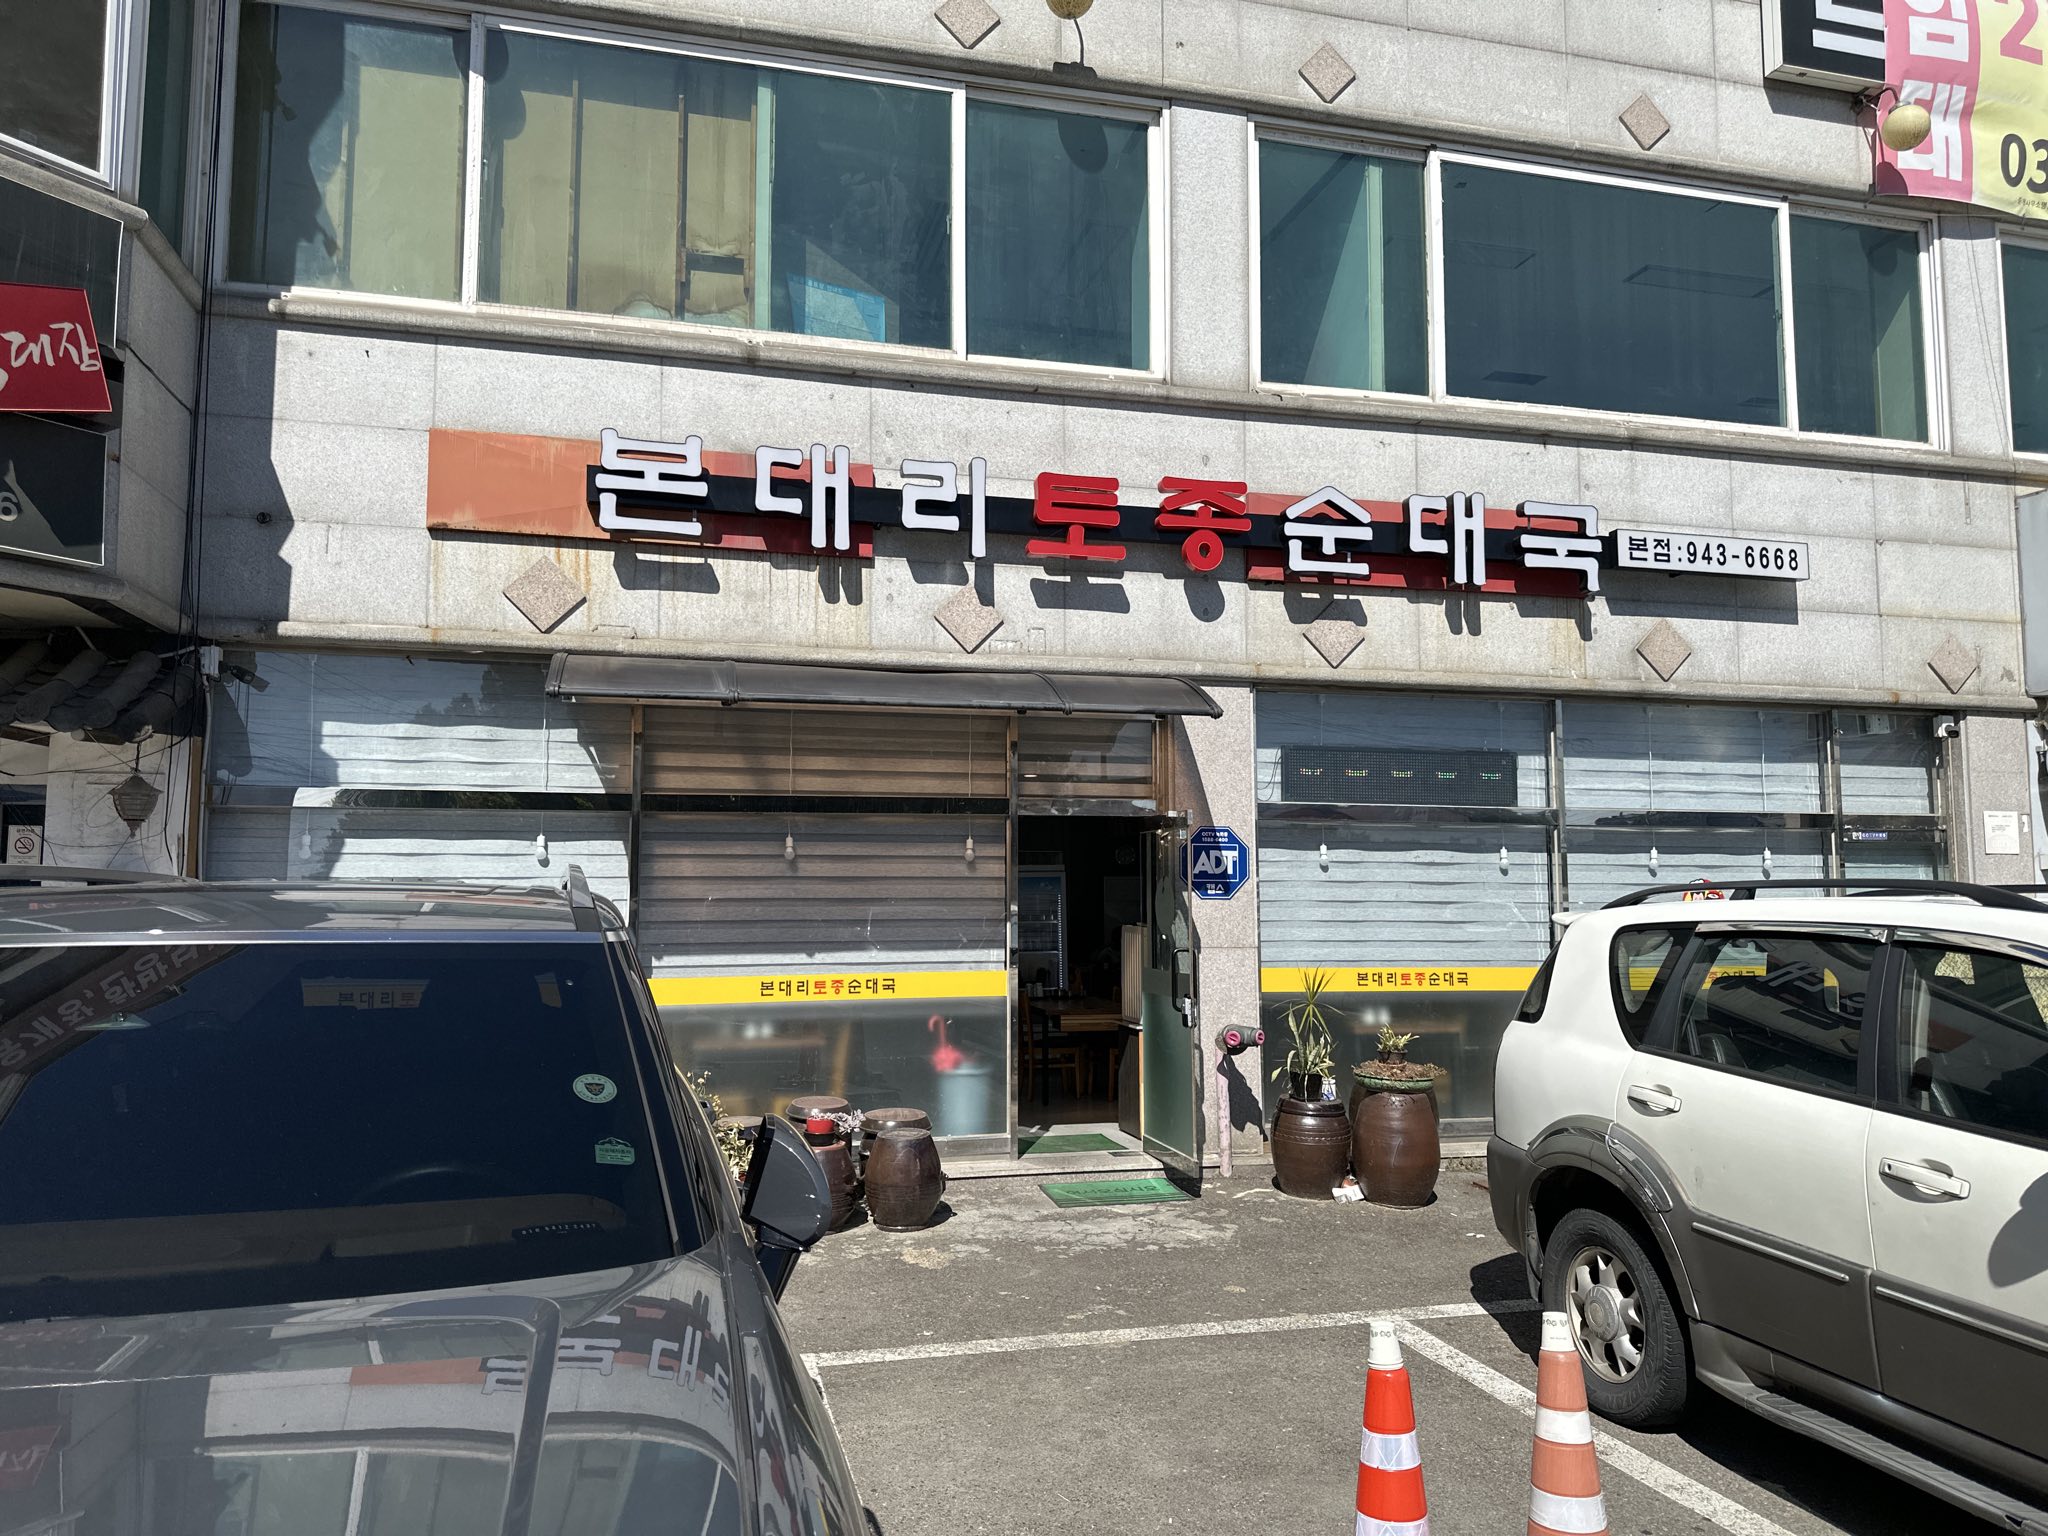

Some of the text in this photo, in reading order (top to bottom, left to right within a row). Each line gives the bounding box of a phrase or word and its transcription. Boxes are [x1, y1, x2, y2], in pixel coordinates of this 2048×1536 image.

[1628, 536, 1798, 571] 본점:943-6668
[1193, 850, 1238, 875] ADT
[760, 978, 896, 997] 본대리토종순대국
[1357, 972, 1469, 987] 본대리토종순대국
